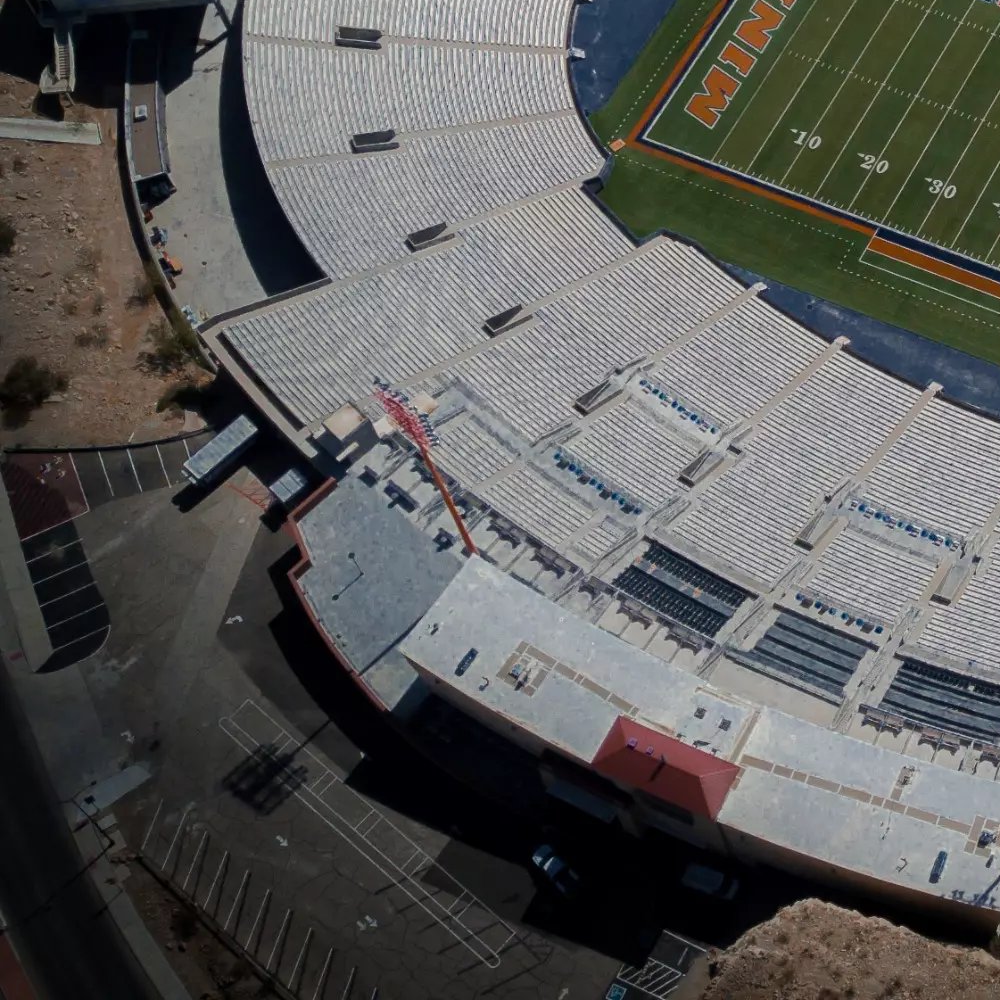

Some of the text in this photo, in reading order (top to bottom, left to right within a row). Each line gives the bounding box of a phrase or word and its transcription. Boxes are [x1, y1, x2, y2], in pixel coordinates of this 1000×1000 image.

[795, 129, 822, 150] 10
[861, 154, 889, 174] 20
[929, 178, 957, 199] 30
